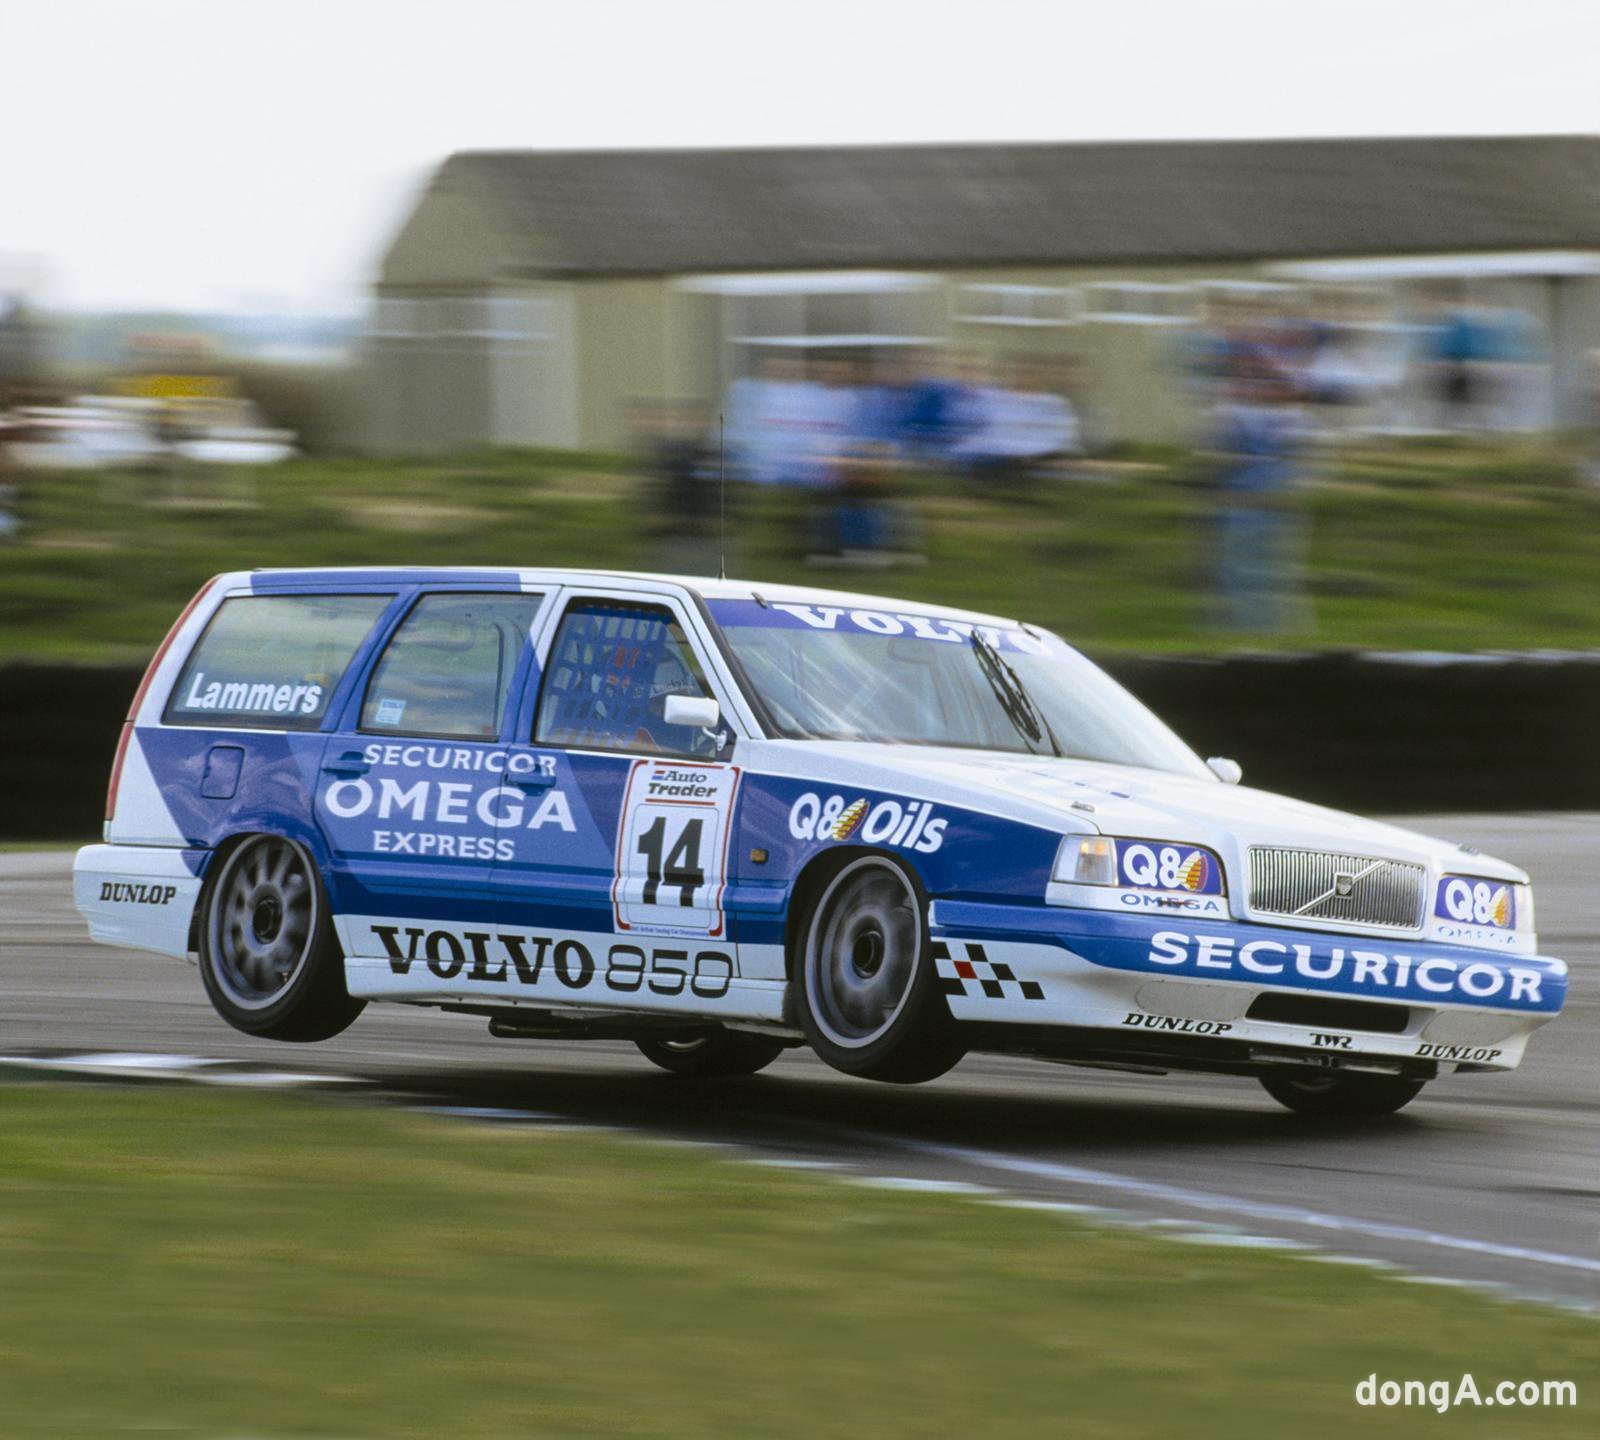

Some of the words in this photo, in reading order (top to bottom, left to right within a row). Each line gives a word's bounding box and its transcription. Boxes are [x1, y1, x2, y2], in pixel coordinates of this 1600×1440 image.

[772, 603, 1054, 656] VOLVO
[186, 673, 322, 713] Lammers
[364, 744, 557, 777] SECURICOR
[664, 770, 707, 783] Auto
[325, 778, 577, 832] OMEGA
[648, 783, 717, 797] Trader
[789, 792, 844, 840] Q8
[861, 800, 949, 853] Oils
[373, 830, 515, 860] EXPRESS
[638, 816, 704, 907] 14
[1123, 844, 1180, 888] Q8
[100, 882, 177, 905] DUNLOP
[1120, 893, 1220, 912] OMEGA
[1445, 879, 1491, 924] Q8
[371, 925, 595, 989] VOLVO
[605, 944, 734, 999] 850
[1148, 931, 1543, 1002] SECURICOR
[1122, 1013, 1232, 1035] DUNLOP
[1310, 1033, 1352, 1049] TWR
[1415, 1043, 1502, 1061] DUNLOP
